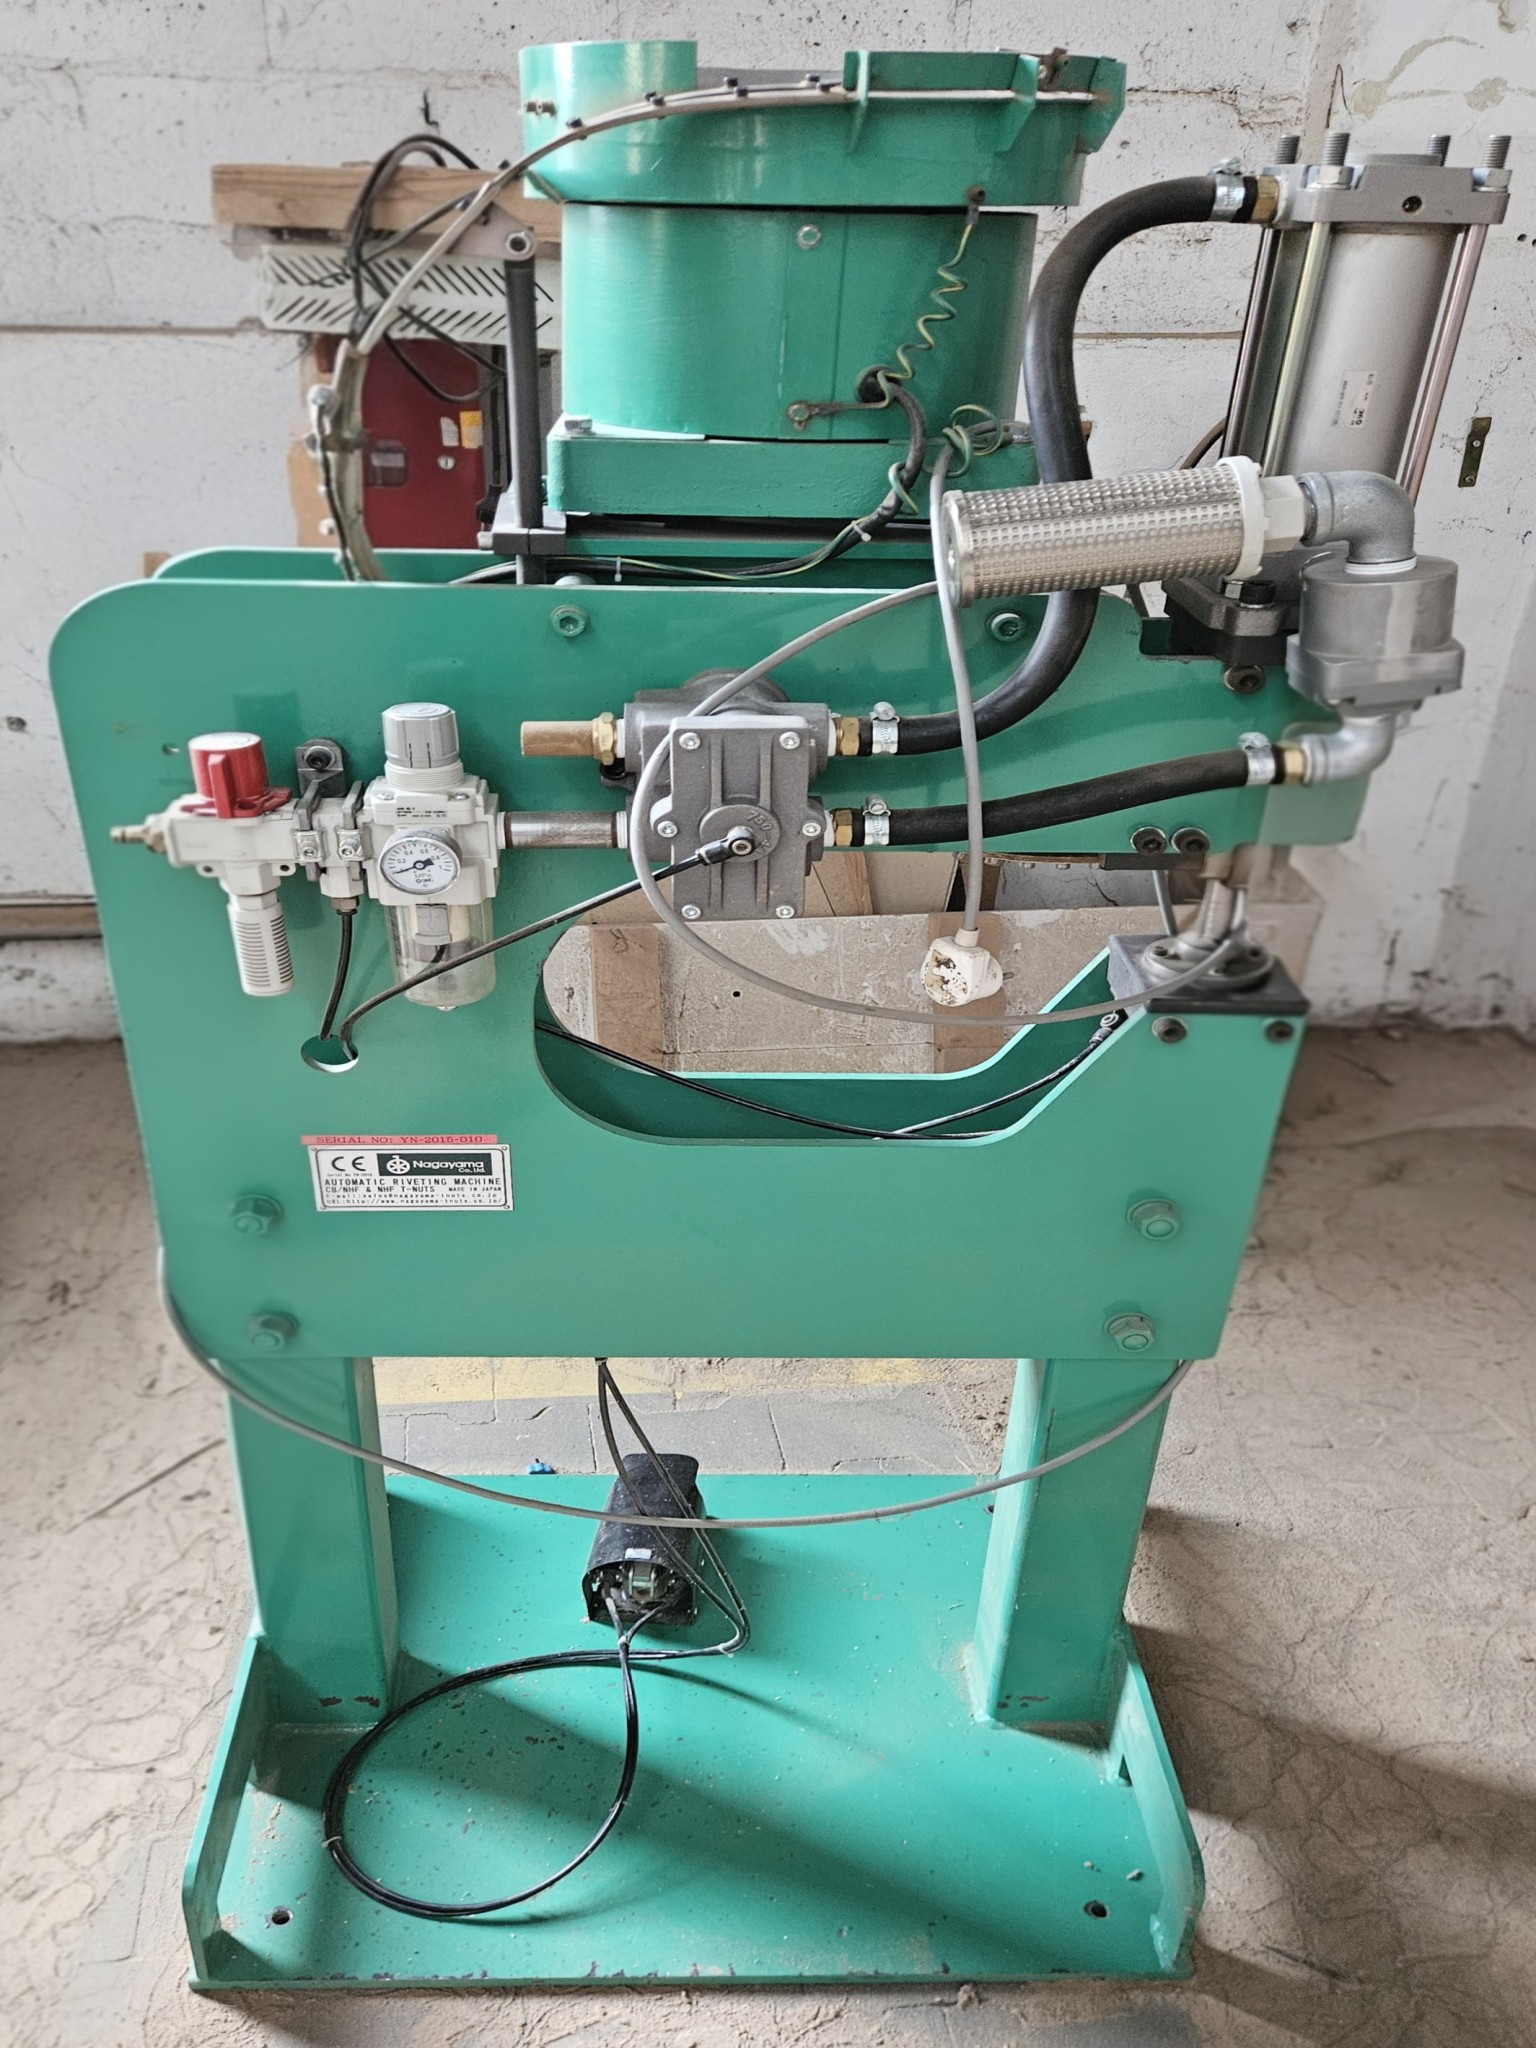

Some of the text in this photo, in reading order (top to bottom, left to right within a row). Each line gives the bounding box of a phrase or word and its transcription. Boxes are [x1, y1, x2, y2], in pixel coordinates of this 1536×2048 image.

[316, 1136, 483, 1144] SERIAL NO: YN-2015-010
[331, 1156, 366, 1172] CE
[412, 1160, 484, 1169] Nagayama
[324, 1177, 502, 1186] AUTOMATIC RIVETING MACHINE
